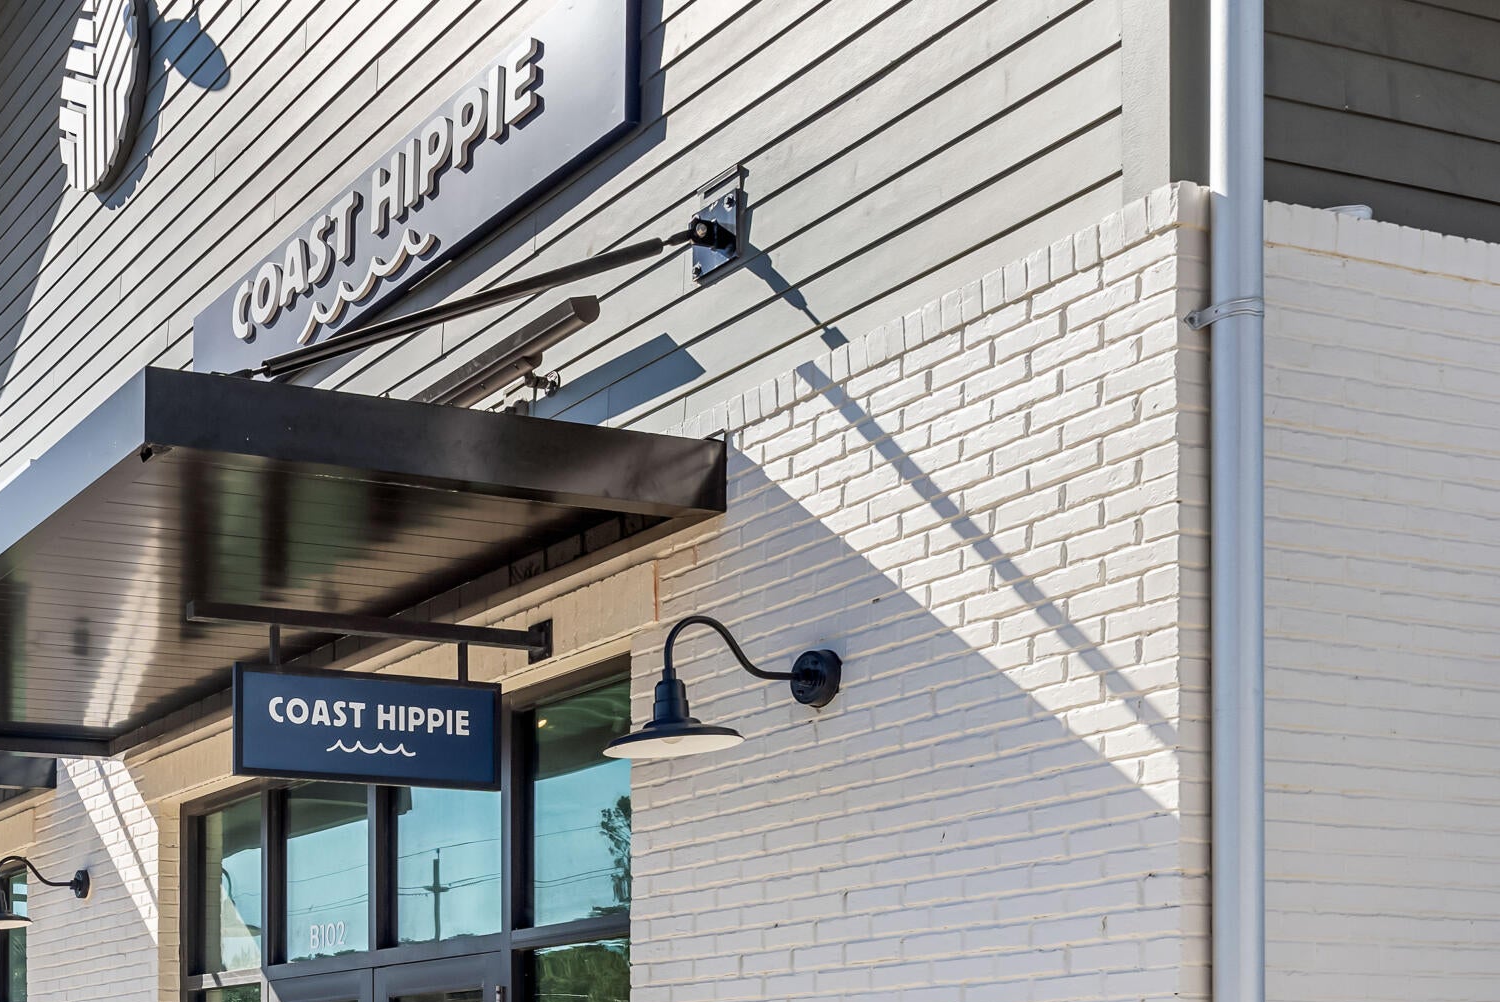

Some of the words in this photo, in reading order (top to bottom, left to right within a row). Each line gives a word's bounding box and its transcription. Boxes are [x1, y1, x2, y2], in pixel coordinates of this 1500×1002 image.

[232, 190, 363, 341] COAST
[370, 37, 544, 238] HIPPIE
[268, 696, 366, 729] COAST
[377, 703, 470, 736] HIPPIE
[309, 920, 347, 949] B102
